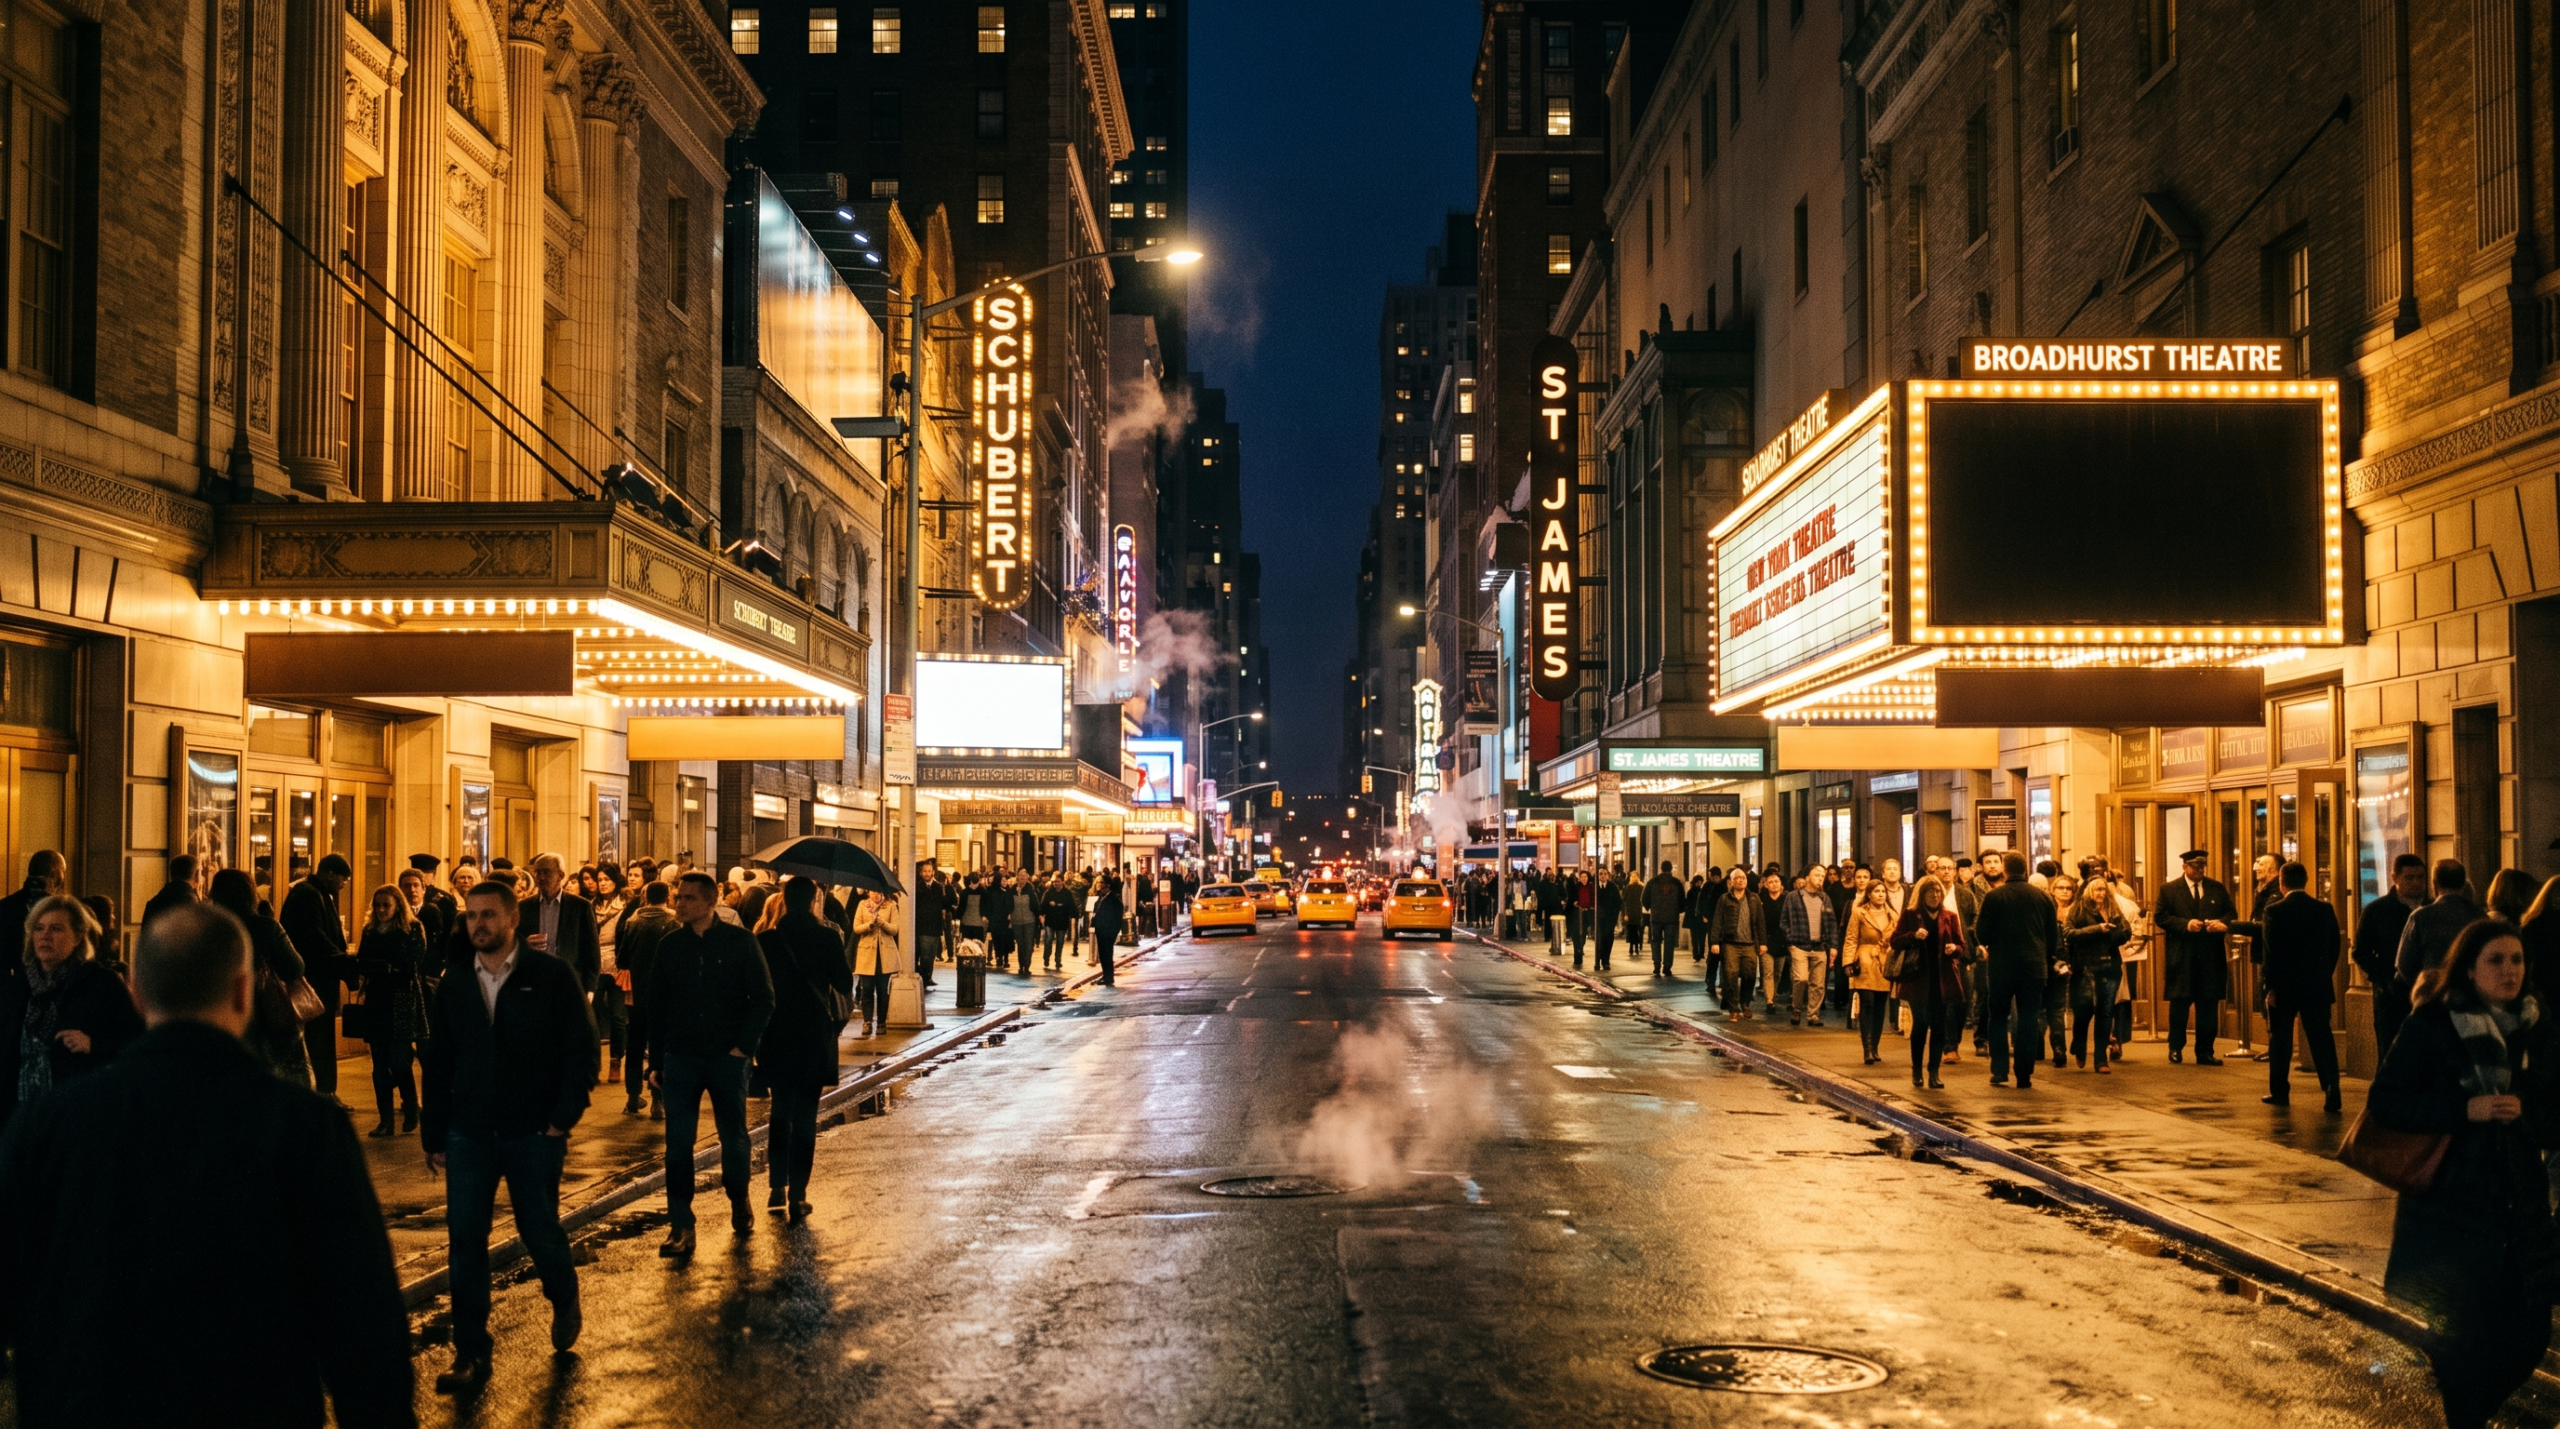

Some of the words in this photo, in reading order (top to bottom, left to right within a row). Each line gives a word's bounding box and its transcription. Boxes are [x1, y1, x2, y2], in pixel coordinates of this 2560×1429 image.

[1974, 345, 2155, 371] BROADHURST
[2163, 345, 2282, 371] THEATRE
[986, 297, 1018, 592] SCHUBERT
[1792, 503, 1837, 563] THEATRE
[1540, 477, 1571, 678] JAMES
[1613, 752, 1637, 767] ST.
[1639, 752, 1690, 767] JAMES
[1694, 752, 1760, 767] THEATRE
